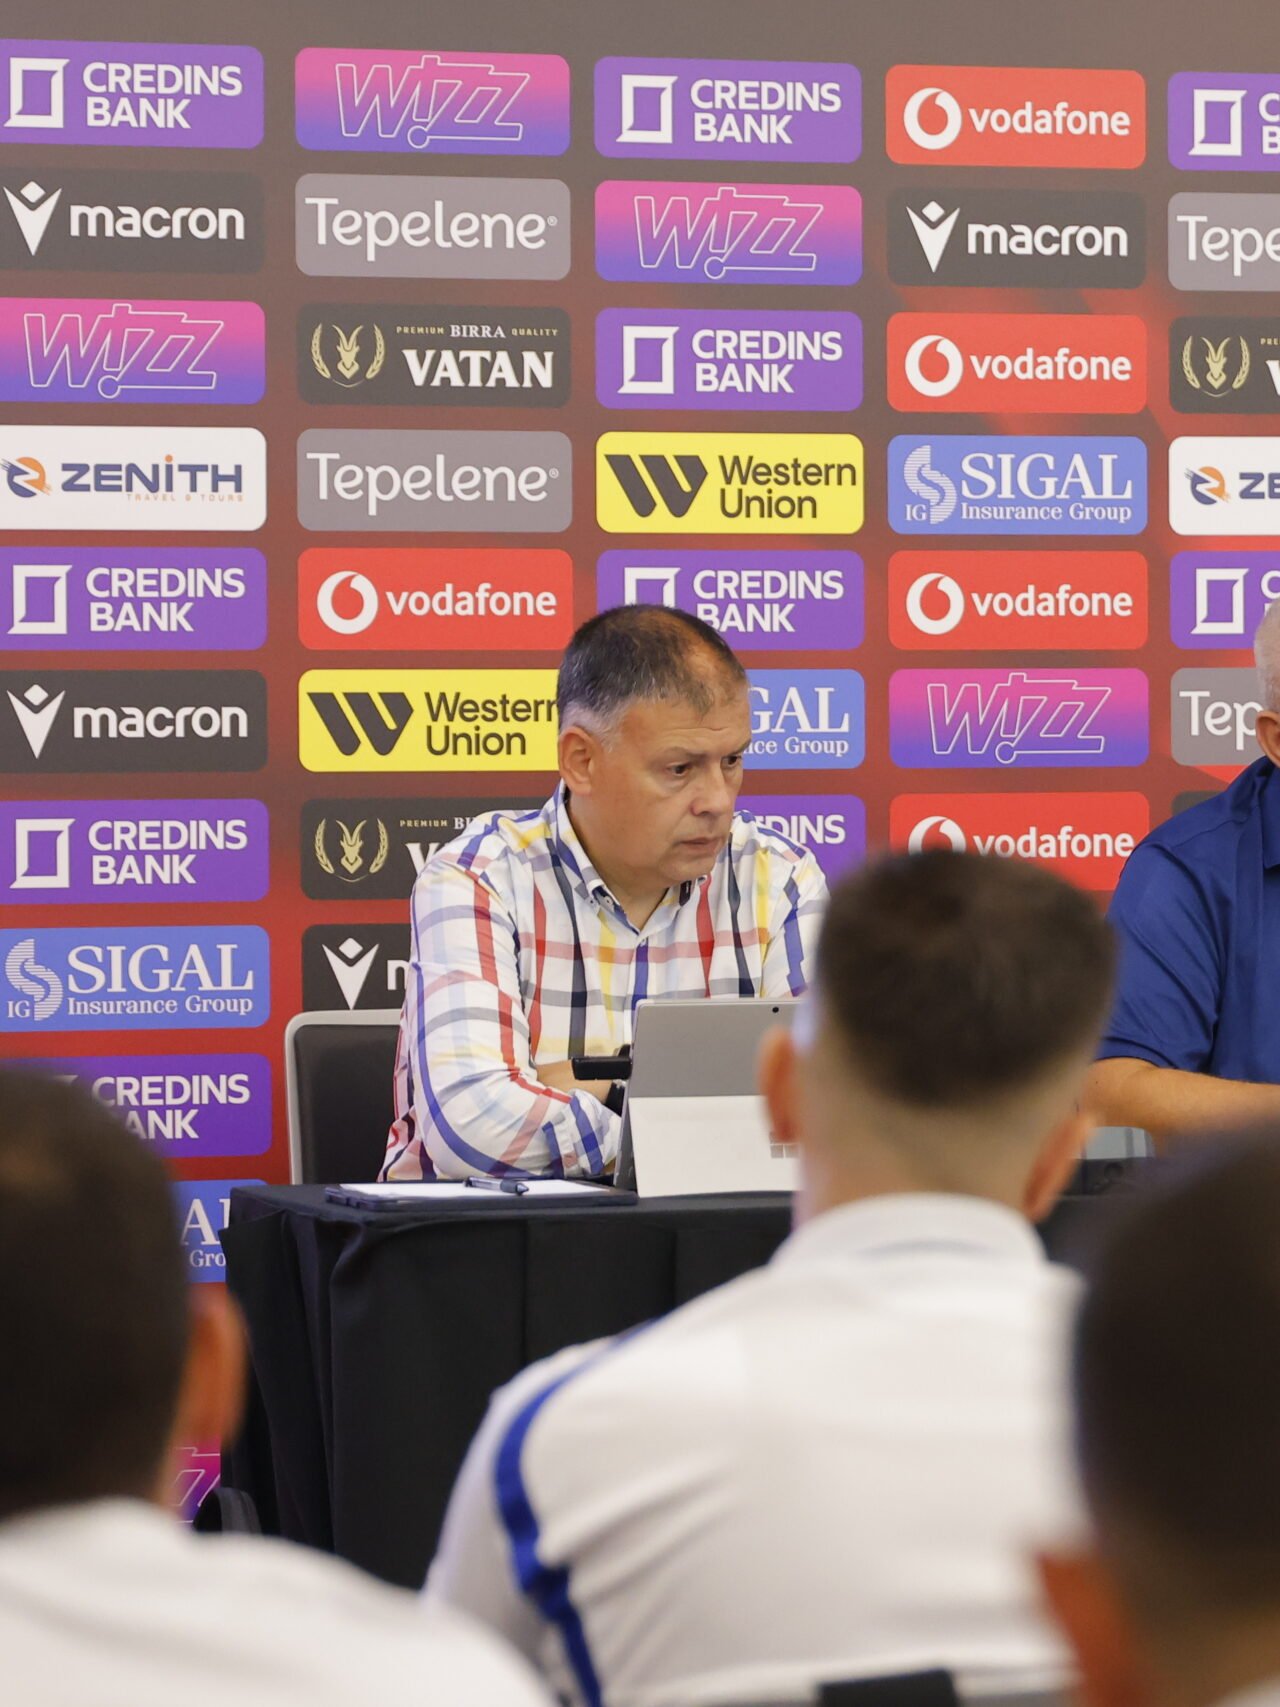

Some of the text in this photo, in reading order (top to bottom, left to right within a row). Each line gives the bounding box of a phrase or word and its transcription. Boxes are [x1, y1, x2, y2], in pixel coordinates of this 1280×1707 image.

[83, 62, 242, 96] CREDINS
[691, 79, 841, 112] CREDINS
[87, 97, 190, 128] BANK
[969, 102, 1130, 135] vodafone
[695, 113, 792, 144] BANK
[71, 205, 244, 239] macron
[968, 224, 1127, 256] macron
[397, 325, 557, 338] PREMIUM BIRRA QUALITY
[692, 329, 842, 361] CREDINS
[402, 350, 553, 387] VATAN
[696, 363, 794, 393] BANK
[970, 348, 1131, 380] vodafone
[719, 455, 856, 486] Western
[962, 453, 1132, 499] SIGAL
[720, 488, 817, 518] Union
[906, 502, 1131, 523] IG Insurance Group
[86, 568, 245, 598] CREDINS
[694, 570, 844, 599] CREDINS
[386, 583, 556, 616] vodafone
[972, 584, 1132, 616] vodafone
[90, 602, 193, 631] BANK
[697, 603, 796, 632] BANK
[74, 707, 247, 738] macron
[749, 687, 849, 733] GAL
[427, 725, 526, 756] Union
[785, 737, 848, 757] Group
[89, 820, 247, 851] CREDINS
[973, 826, 1134, 858] vodafone
[93, 854, 196, 884] BANK
[68, 944, 253, 993] SIGAL
[8, 995, 253, 1018] IG Insurance Group
[92, 1074, 250, 1107] CREDINS
[125, 1109, 199, 1140] ANK
